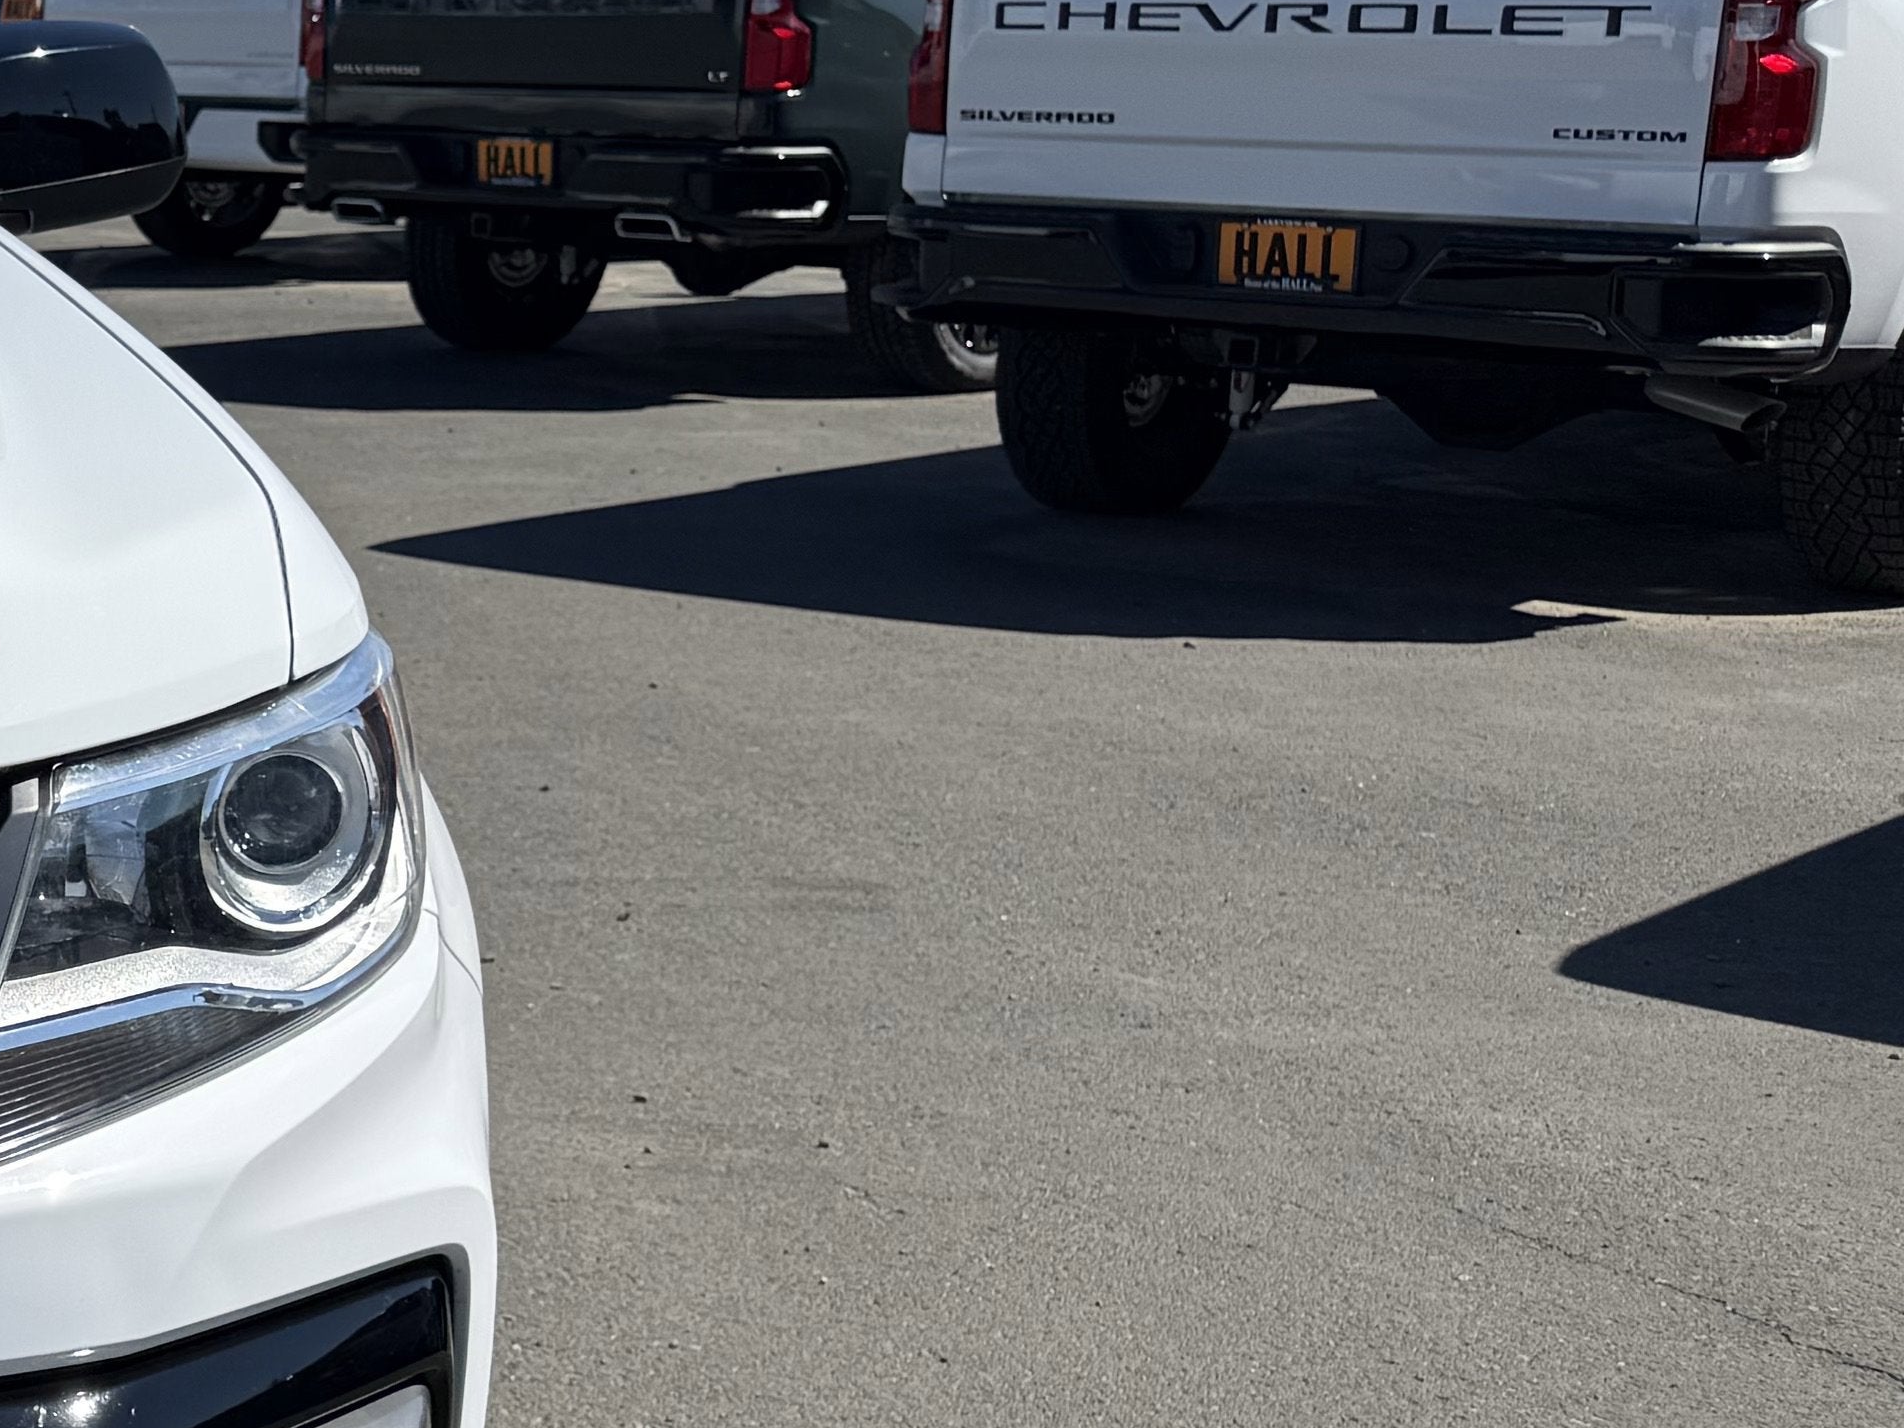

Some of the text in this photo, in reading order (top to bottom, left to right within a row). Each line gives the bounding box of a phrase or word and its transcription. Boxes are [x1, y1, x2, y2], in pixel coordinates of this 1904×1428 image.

[994, 0, 1653, 38] CHEVROLET
[958, 108, 1116, 124] SILVERADO
[1552, 127, 1689, 144] CUSTOM
[486, 143, 544, 179] HALL
[1234, 231, 1340, 284] HALL
